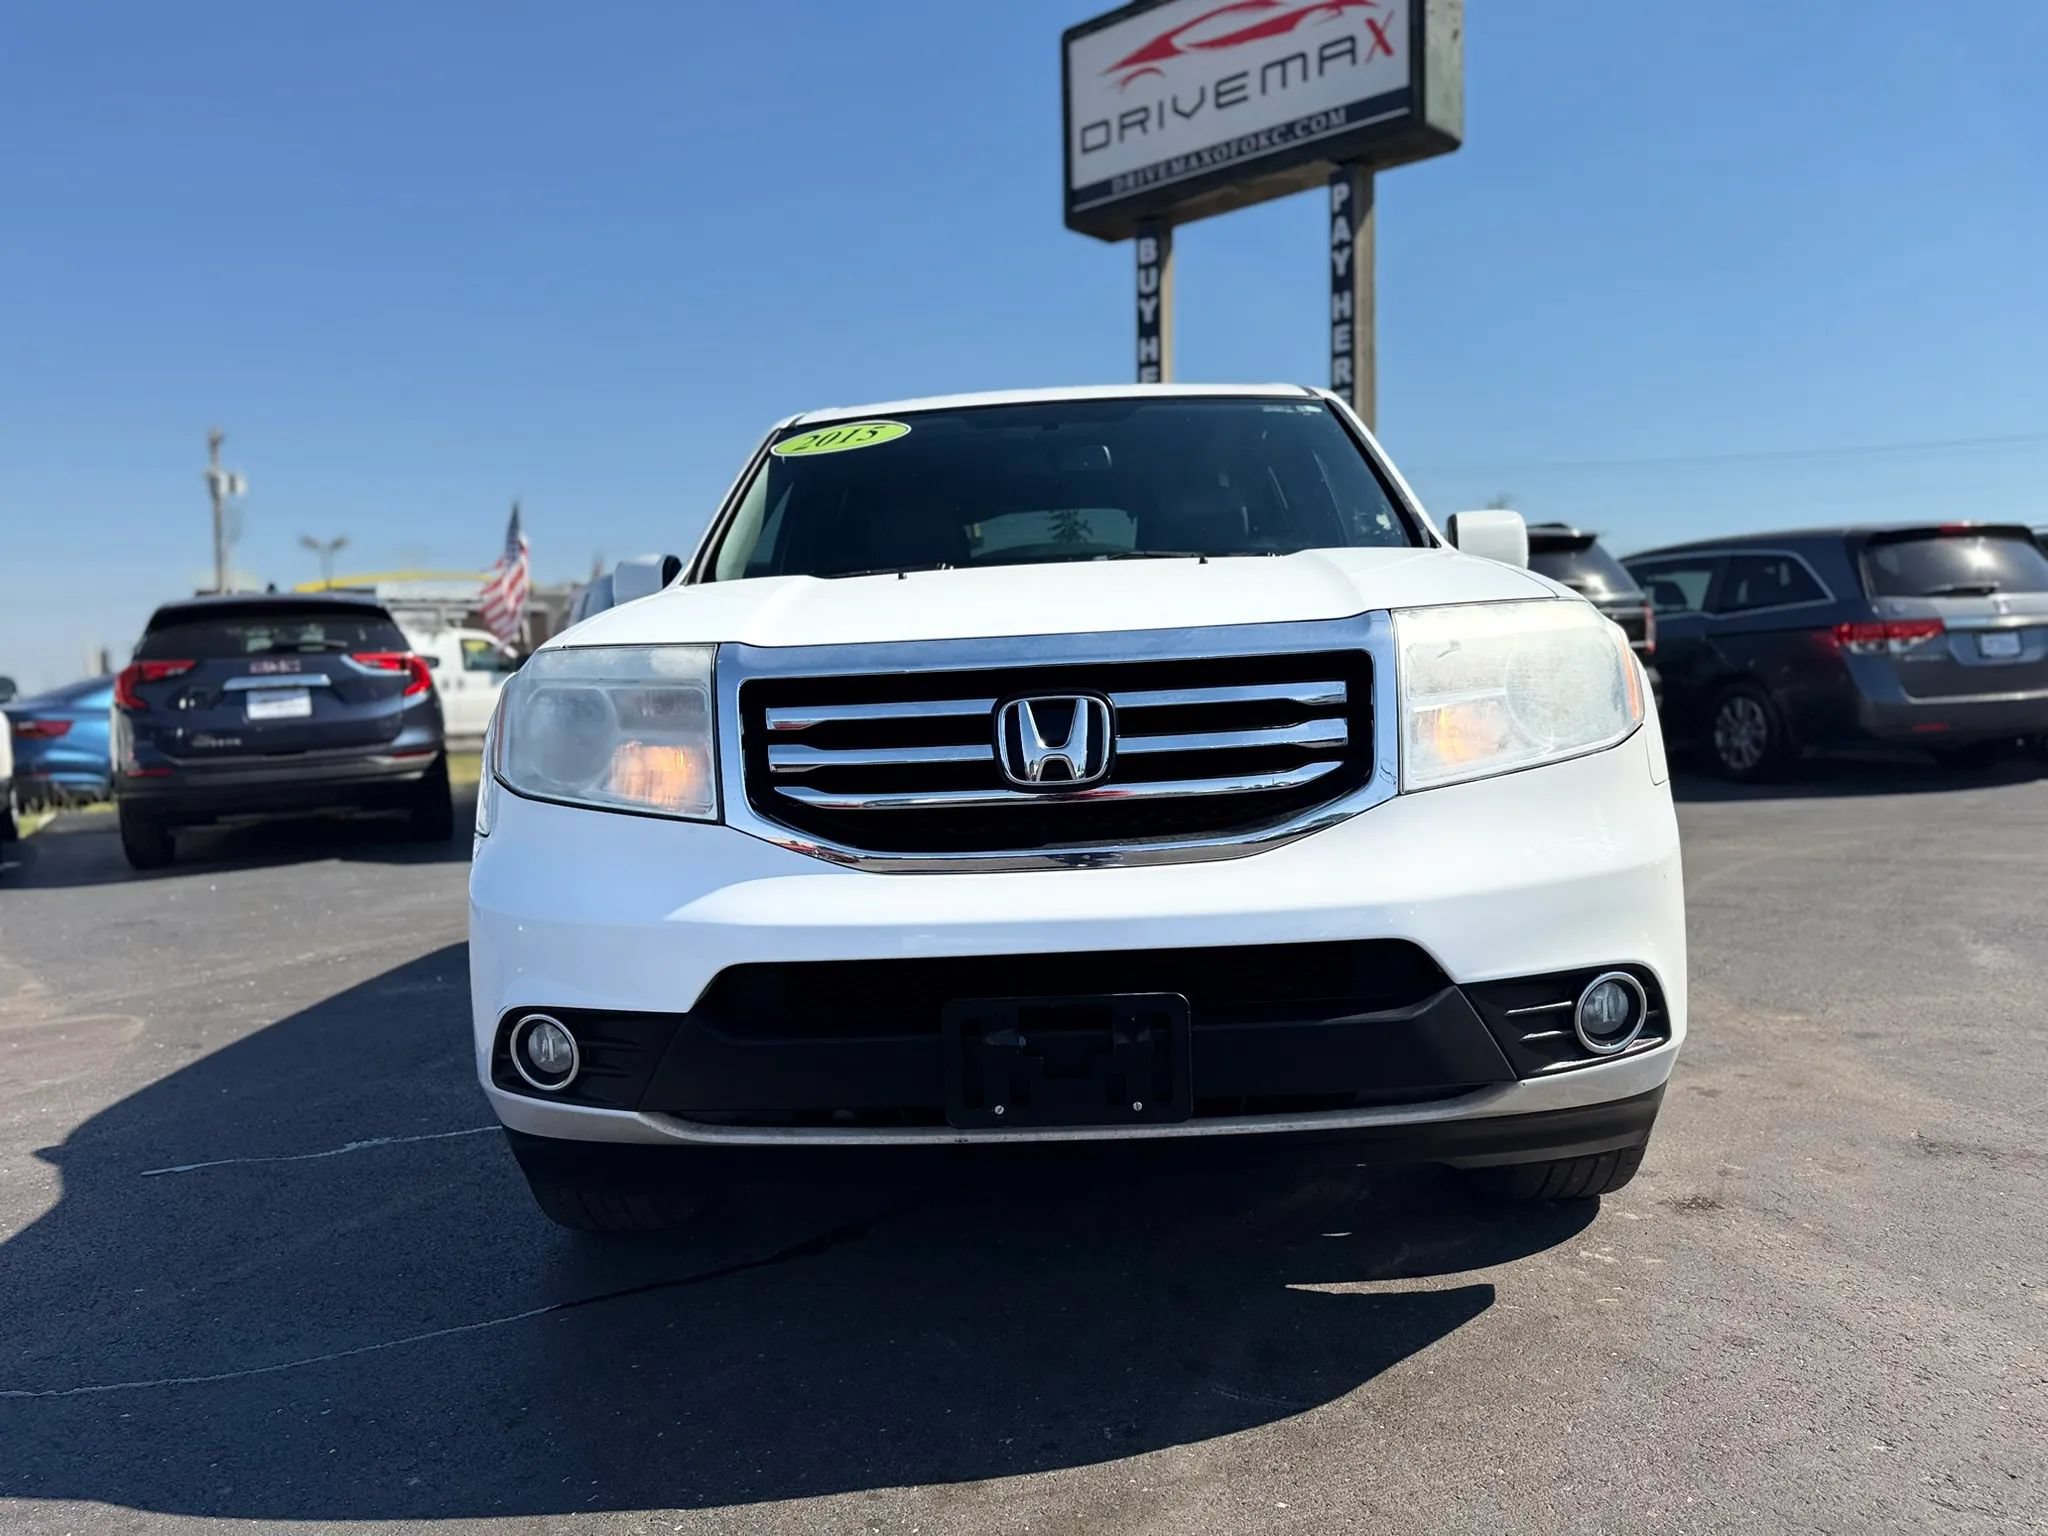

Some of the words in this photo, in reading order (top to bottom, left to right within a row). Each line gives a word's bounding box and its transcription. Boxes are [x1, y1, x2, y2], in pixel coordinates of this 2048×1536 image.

[1079, 9, 1395, 156] DRIVEMAX
[1110, 107, 1348, 195] DRIVEMAXOFOKC.COM
[1331, 182, 1352, 277] PAY
[1138, 237, 1158, 323] BUY
[791, 426, 887, 451] 2015
